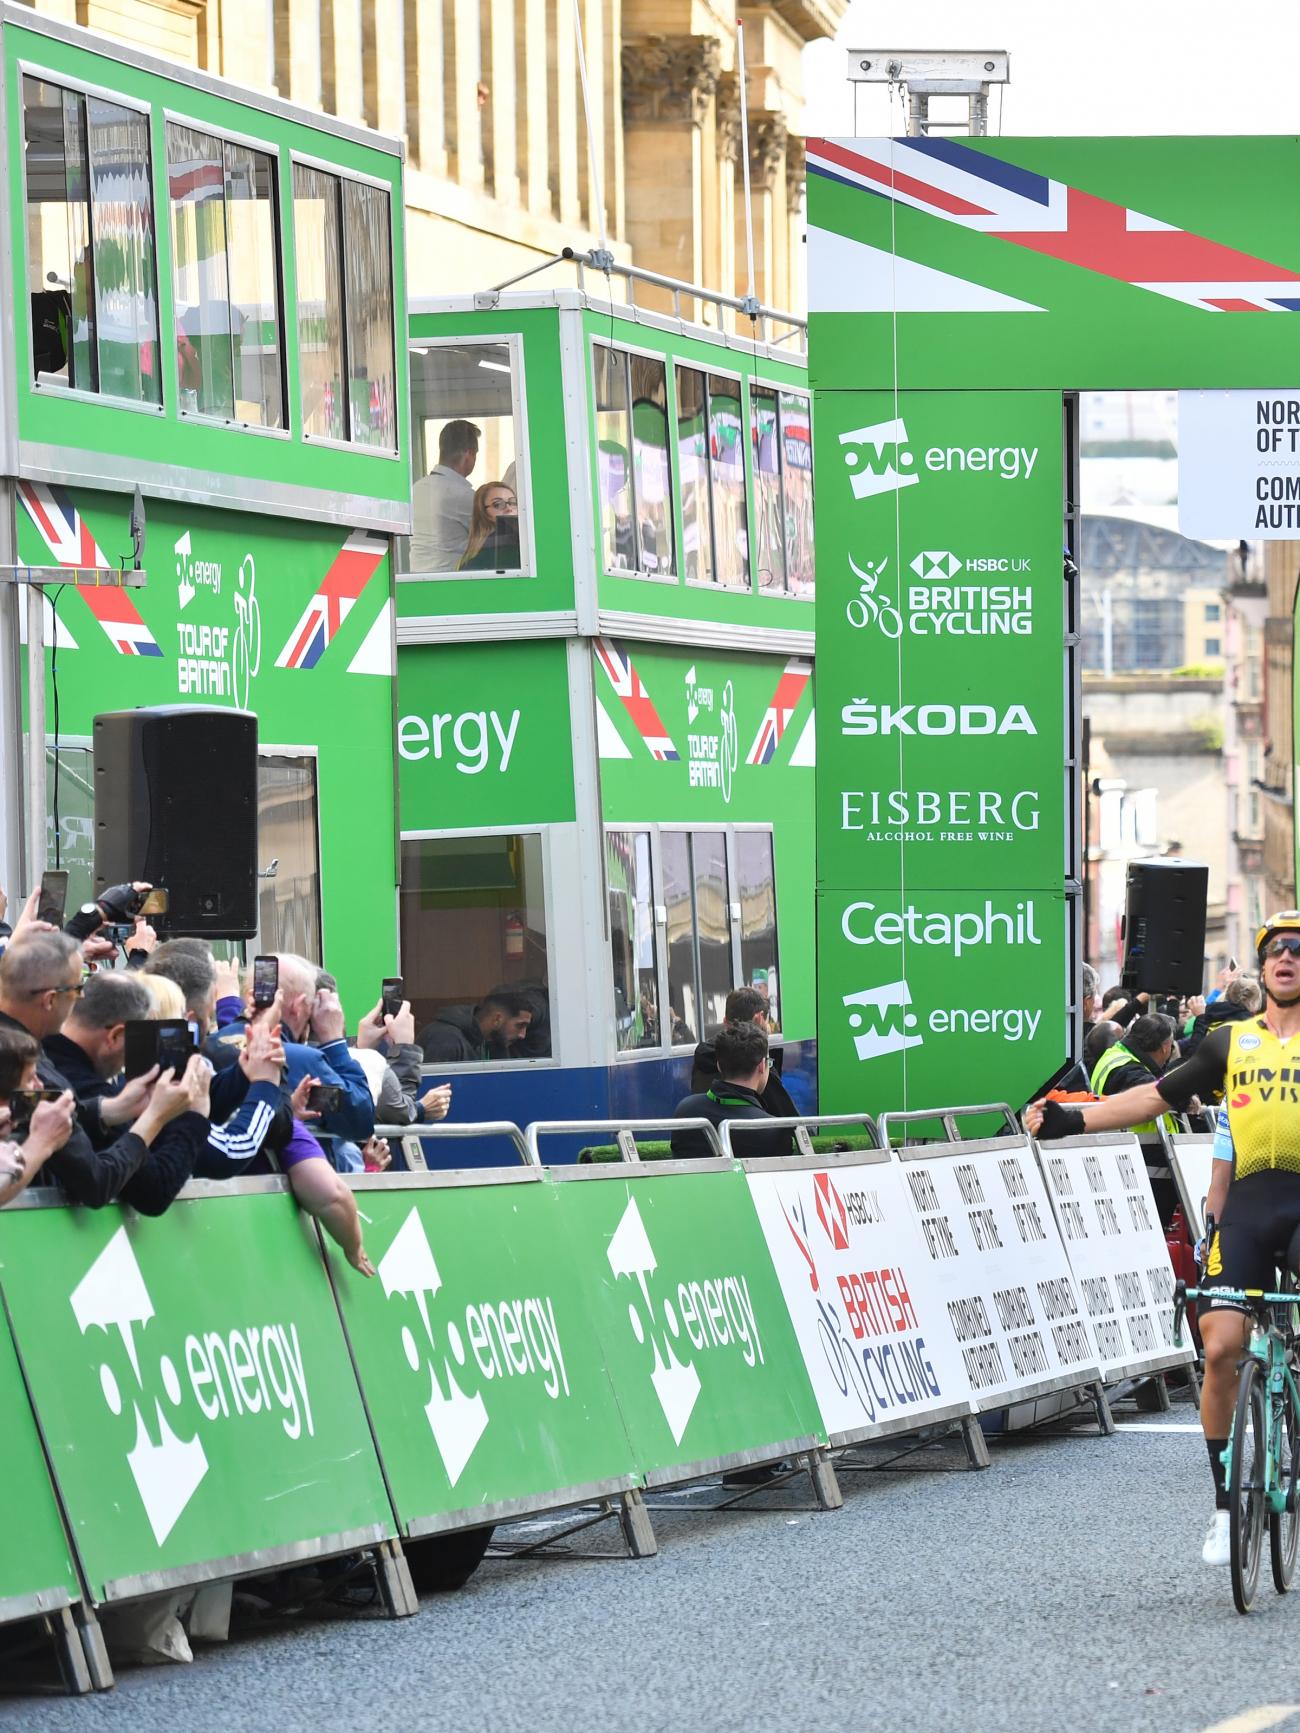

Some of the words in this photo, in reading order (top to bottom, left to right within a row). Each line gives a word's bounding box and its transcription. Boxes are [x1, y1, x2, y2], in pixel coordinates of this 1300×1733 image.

[1255, 428, 1283, 453] OF
[925, 444, 1039, 481] energy
[194, 560, 222, 594] energy
[965, 557, 1009, 572] HSBC
[1011, 557, 1032, 572] UK
[908, 586, 1033, 610] BRITISH
[177, 622, 212, 656] TOUR
[212, 626, 229, 658] OF
[908, 611, 1033, 635] CYCLING
[178, 658, 231, 696] BRITAIN
[841, 697, 1038, 736] ŠKODA
[397, 709, 521, 774] ergy
[840, 791, 1041, 831] EISBERG
[866, 831, 934, 842] ALCOHOL
[940, 831, 974, 842] FREE
[978, 831, 1014, 842] WINE
[841, 900, 1042, 957] Cetaphil
[928, 1008, 1042, 1041] energy
[843, 1191, 873, 1226] HSBC
[677, 1275, 765, 1368] energy
[836, 1267, 919, 1340] BRITISH
[465, 1296, 571, 1399] energy
[184, 1322, 315, 1440] energy
[862, 1337, 941, 1409] CYCLING
